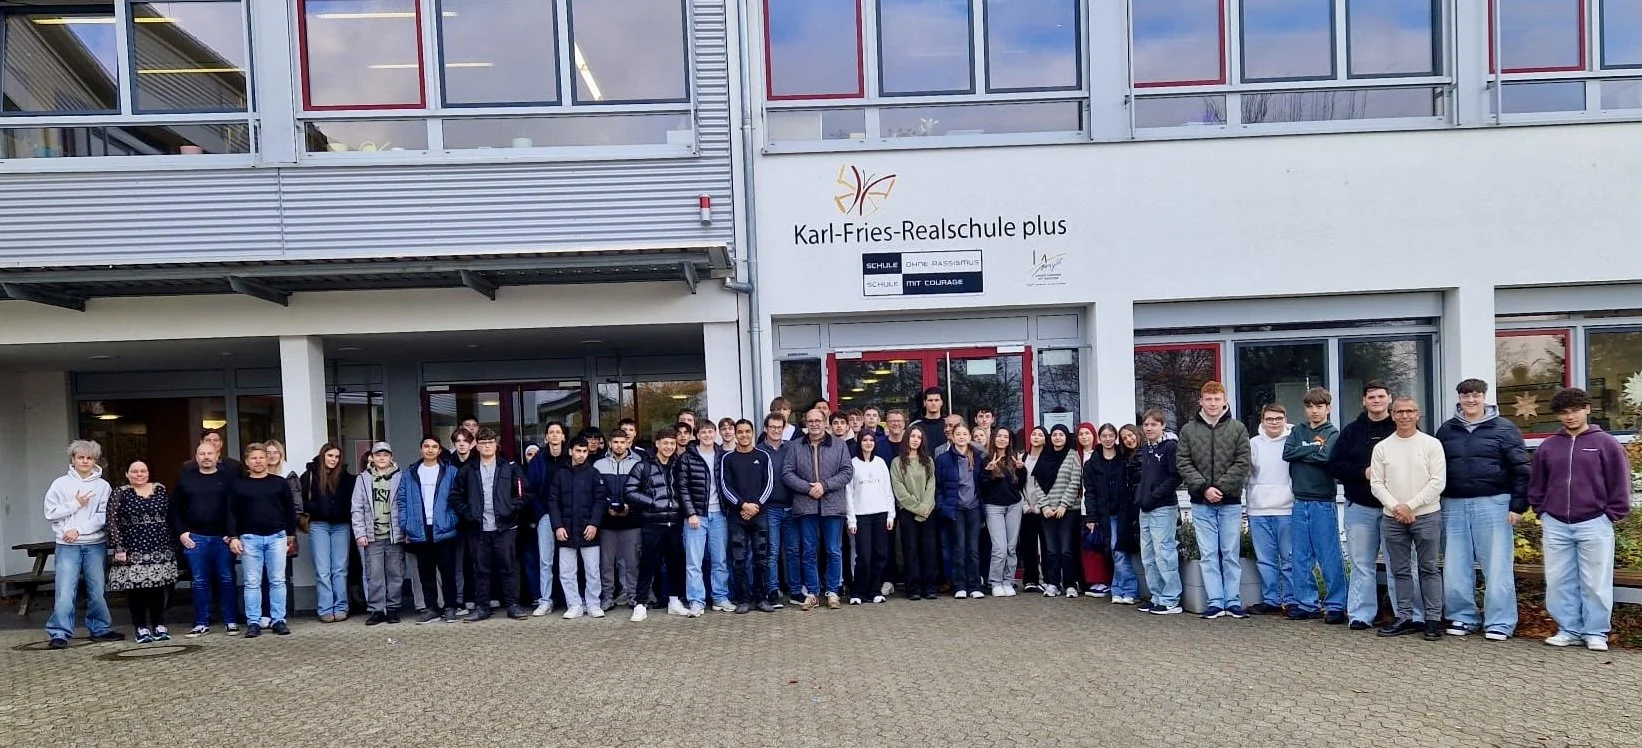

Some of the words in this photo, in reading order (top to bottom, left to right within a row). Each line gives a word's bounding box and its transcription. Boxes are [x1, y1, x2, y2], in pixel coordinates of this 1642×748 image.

[794, 215, 1016, 245] Karl-Fries-Realschule
[1023, 215, 1067, 239] plus
[866, 261, 898, 269] SCHULE
[932, 259, 980, 267] RASSISMUS
[924, 279, 963, 287] COURAGE
